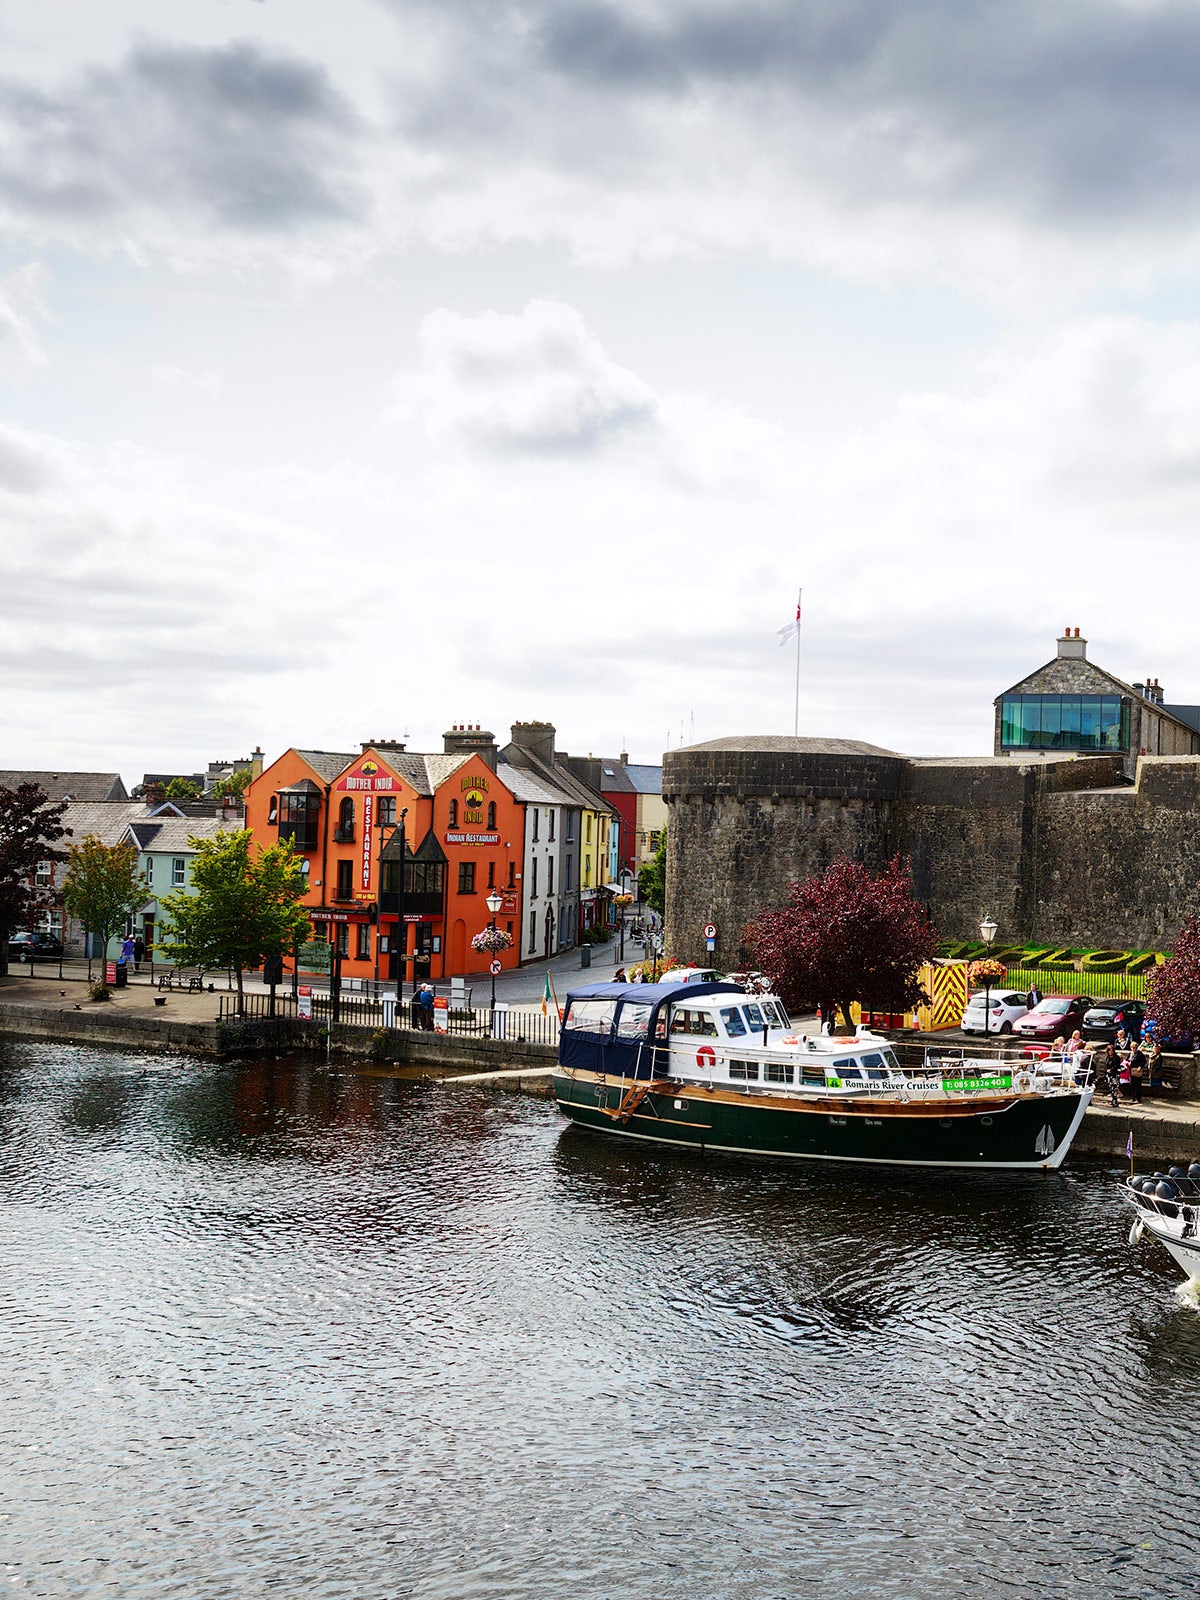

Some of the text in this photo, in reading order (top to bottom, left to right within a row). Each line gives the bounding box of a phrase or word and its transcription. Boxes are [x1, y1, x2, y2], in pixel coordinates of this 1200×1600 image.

[346, 776, 393, 790] MOTHER INDIA
[461, 776, 489, 793] MOTHER
[464, 811, 483, 824] INDIA
[363, 796, 372, 888] RESTAURANT
[708, 926, 714, 936] P
[845, 1080, 880, 1089] Romaris
[882, 1081, 904, 1090] River
[906, 1082, 939, 1090] Cruises
[954, 1080, 968, 1088] 085
[992, 1078, 1006, 1086] 403
